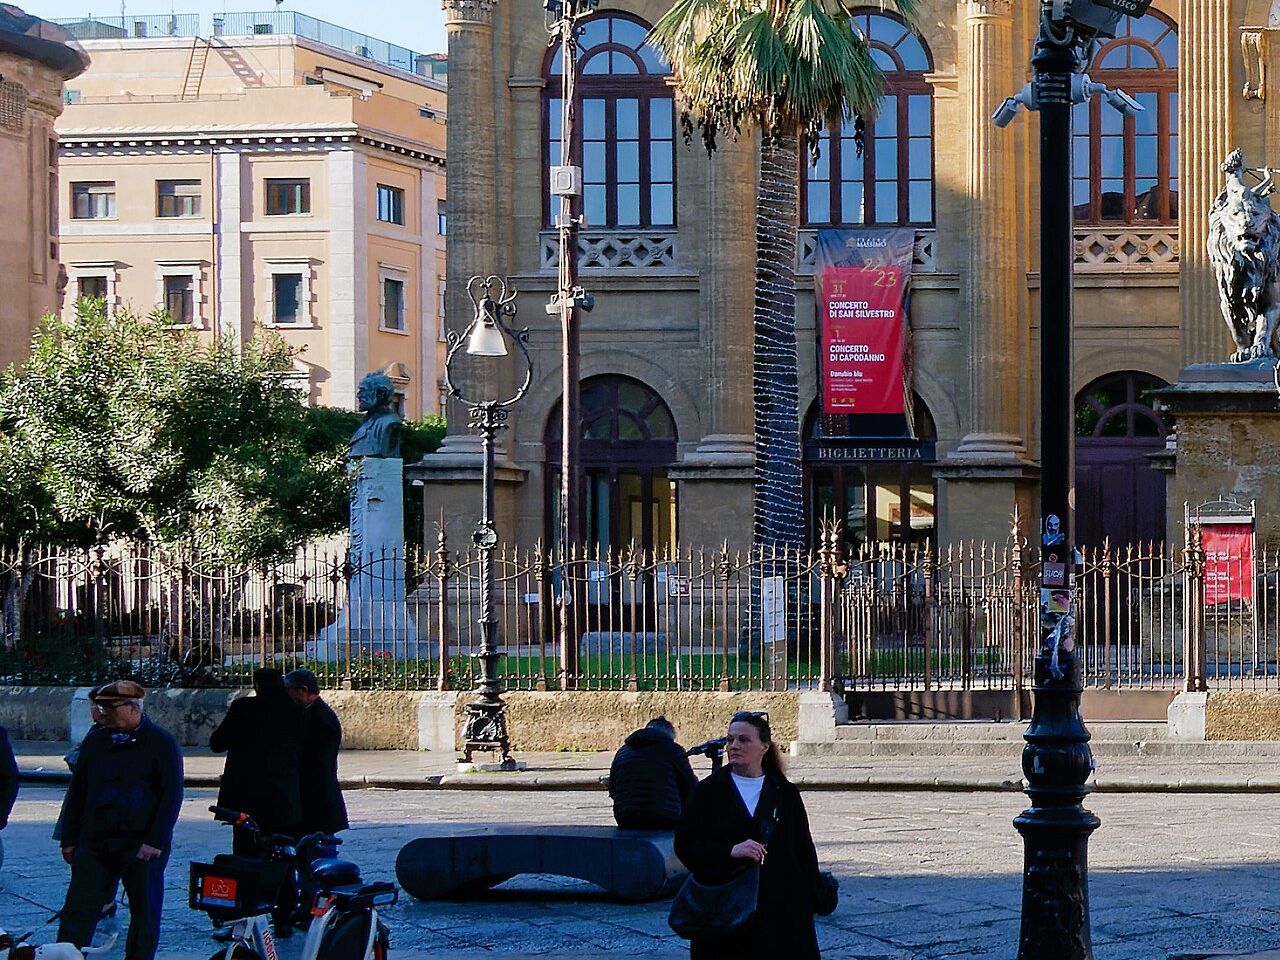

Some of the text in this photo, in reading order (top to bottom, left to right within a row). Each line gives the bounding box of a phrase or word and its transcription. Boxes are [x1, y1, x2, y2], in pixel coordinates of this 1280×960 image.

[874, 271, 897, 288] 23
[829, 301, 868, 309] CONCERTO
[829, 310, 895, 318] DI SAN SILVESTRO
[830, 344, 869, 353] CONCERTO
[830, 353, 885, 362] DI CAPODANNO
[818, 447, 922, 459] BIGLIETTERIA
